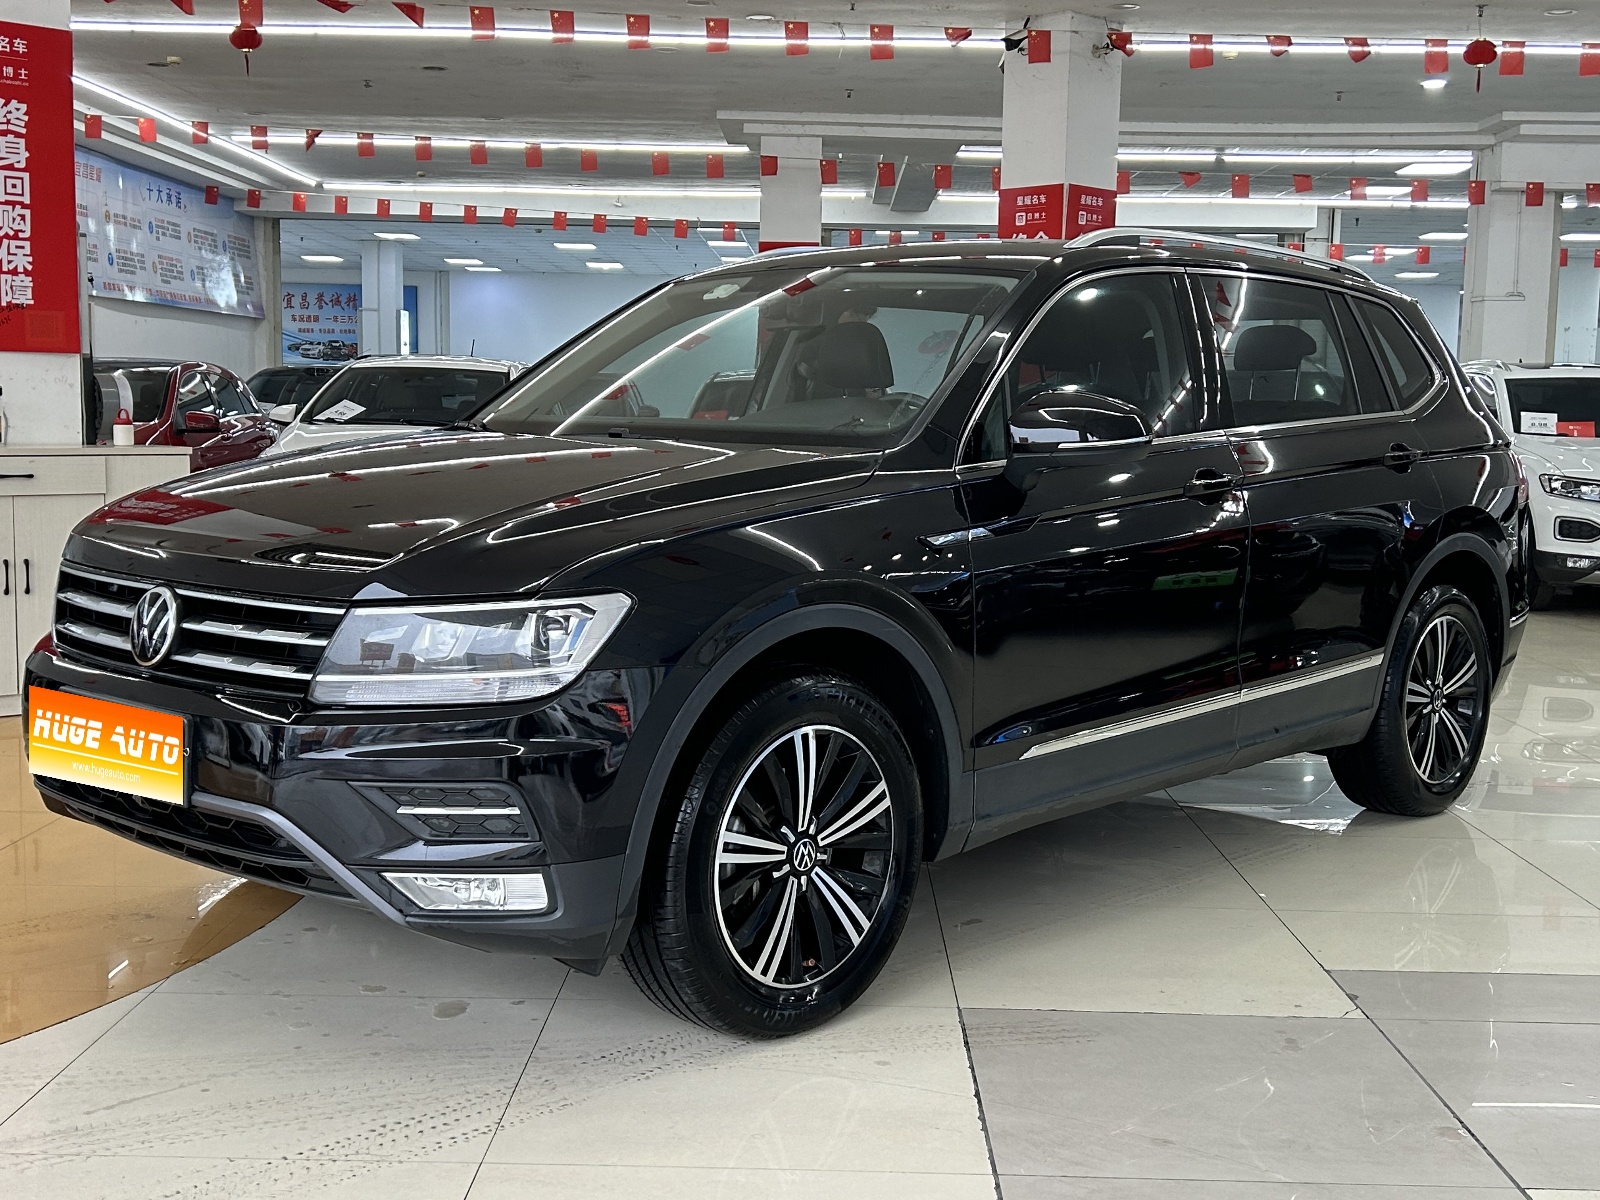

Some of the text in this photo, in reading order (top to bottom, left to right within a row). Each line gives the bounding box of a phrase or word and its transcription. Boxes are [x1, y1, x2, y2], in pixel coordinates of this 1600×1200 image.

[0, 36, 28, 54] 名车
[3, 65, 28, 79] 博士
[0, 98, 35, 307] 终身回购保障
[147, 181, 182, 209] 十大承诺
[1016, 194, 1047, 206] 星耀名车
